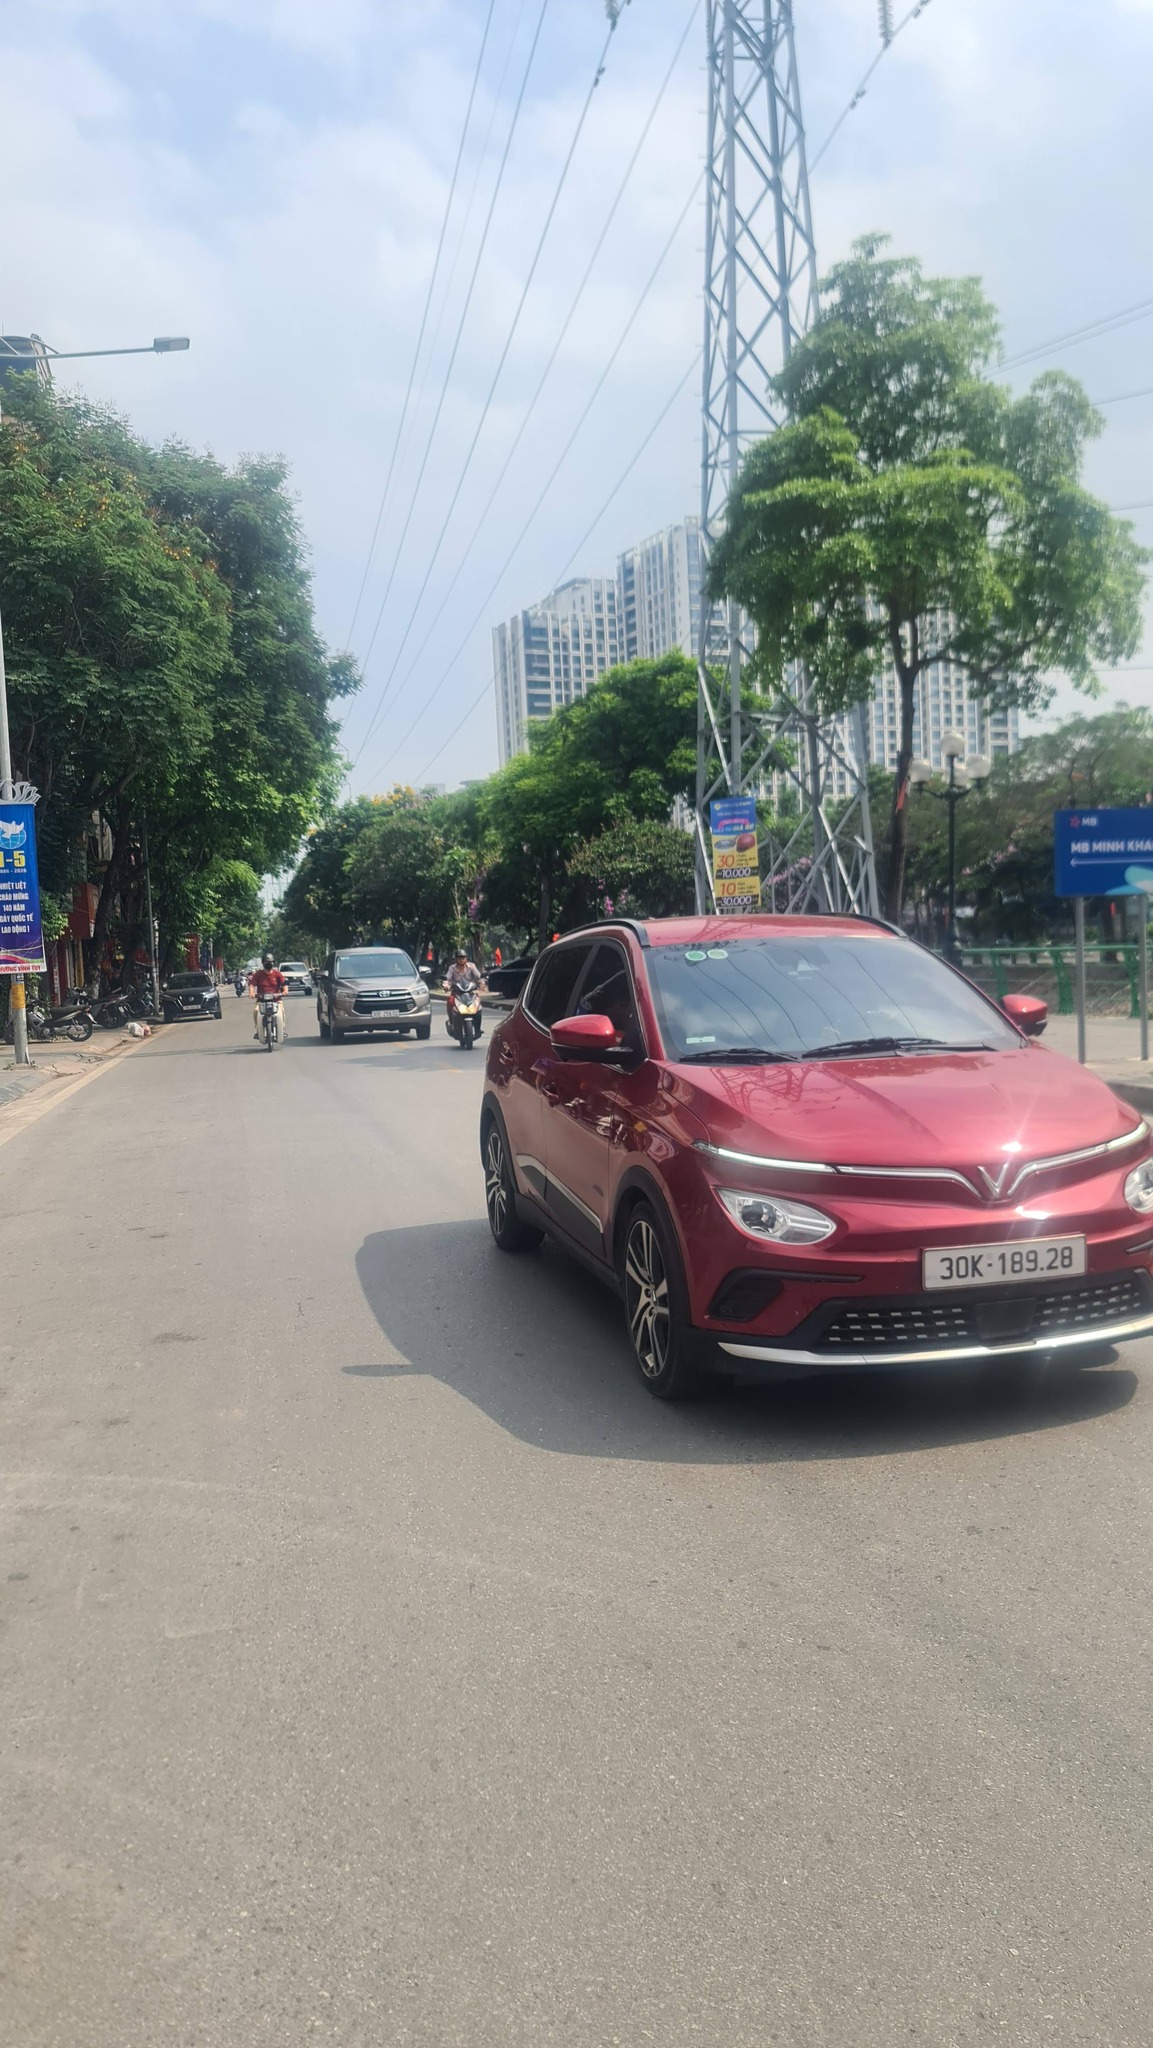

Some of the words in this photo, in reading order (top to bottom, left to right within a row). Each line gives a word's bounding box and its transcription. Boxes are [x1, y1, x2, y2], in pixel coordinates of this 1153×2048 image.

[1082, 817, 1097, 826] MB
[1071, 841, 1089, 853] MB
[1092, 841, 1124, 852] MINH
[1127, 840, 1153, 852] KHA
[717, 854, 735, 868] 30
[722, 868, 751, 878] 10.000
[15, 881, 26, 890] LIỆT
[720, 882, 737, 895] 10
[721, 896, 752, 906] 30.000
[0, 914, 10, 922] GÀY
[11, 913, 26, 923] QUỐC
[27, 912, 34, 921] TẾ
[12, 925, 26, 934] ĐỘNG
[939, 1246, 1073, 1280] 30K-189.28
